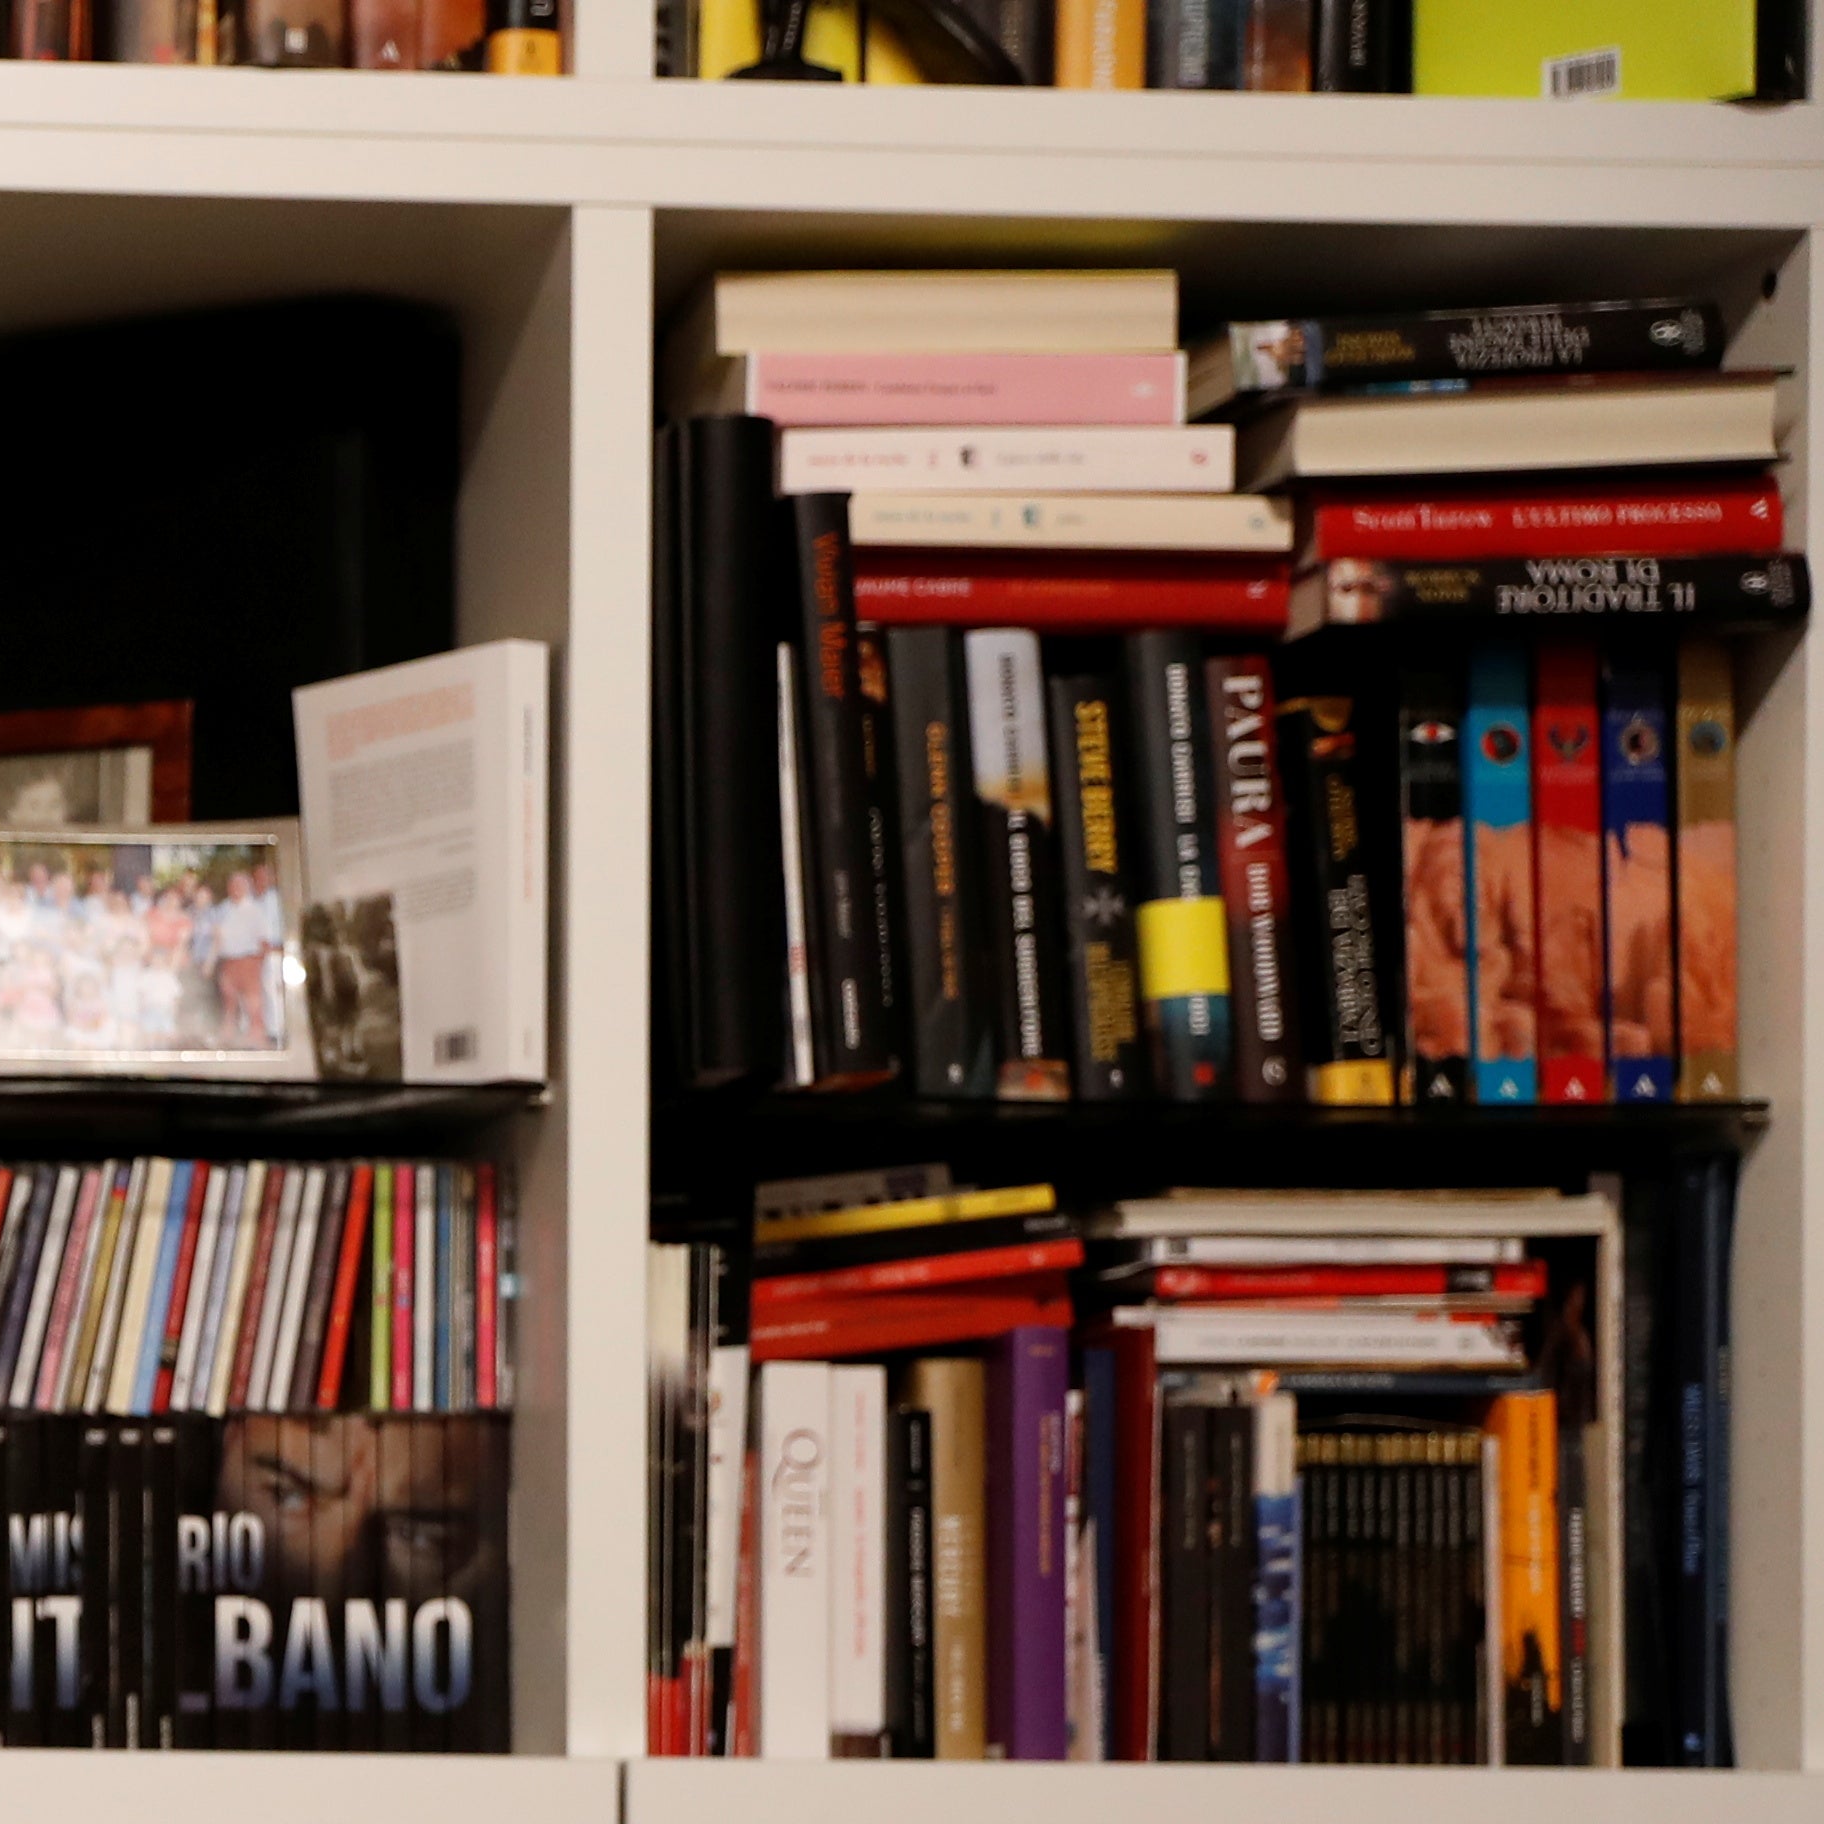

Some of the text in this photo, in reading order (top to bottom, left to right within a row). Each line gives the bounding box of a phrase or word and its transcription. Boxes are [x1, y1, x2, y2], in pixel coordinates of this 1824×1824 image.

[1494, 582, 1697, 615] IL TRADITORE
[1523, 558, 1660, 585] DI ROMA
[820, 620, 849, 700] Maier
[1222, 673, 1285, 1043] PAURA BOB WOODWARD
[772, 1427, 825, 1578] QUEEN
[216, 1595, 472, 1712] BANO
